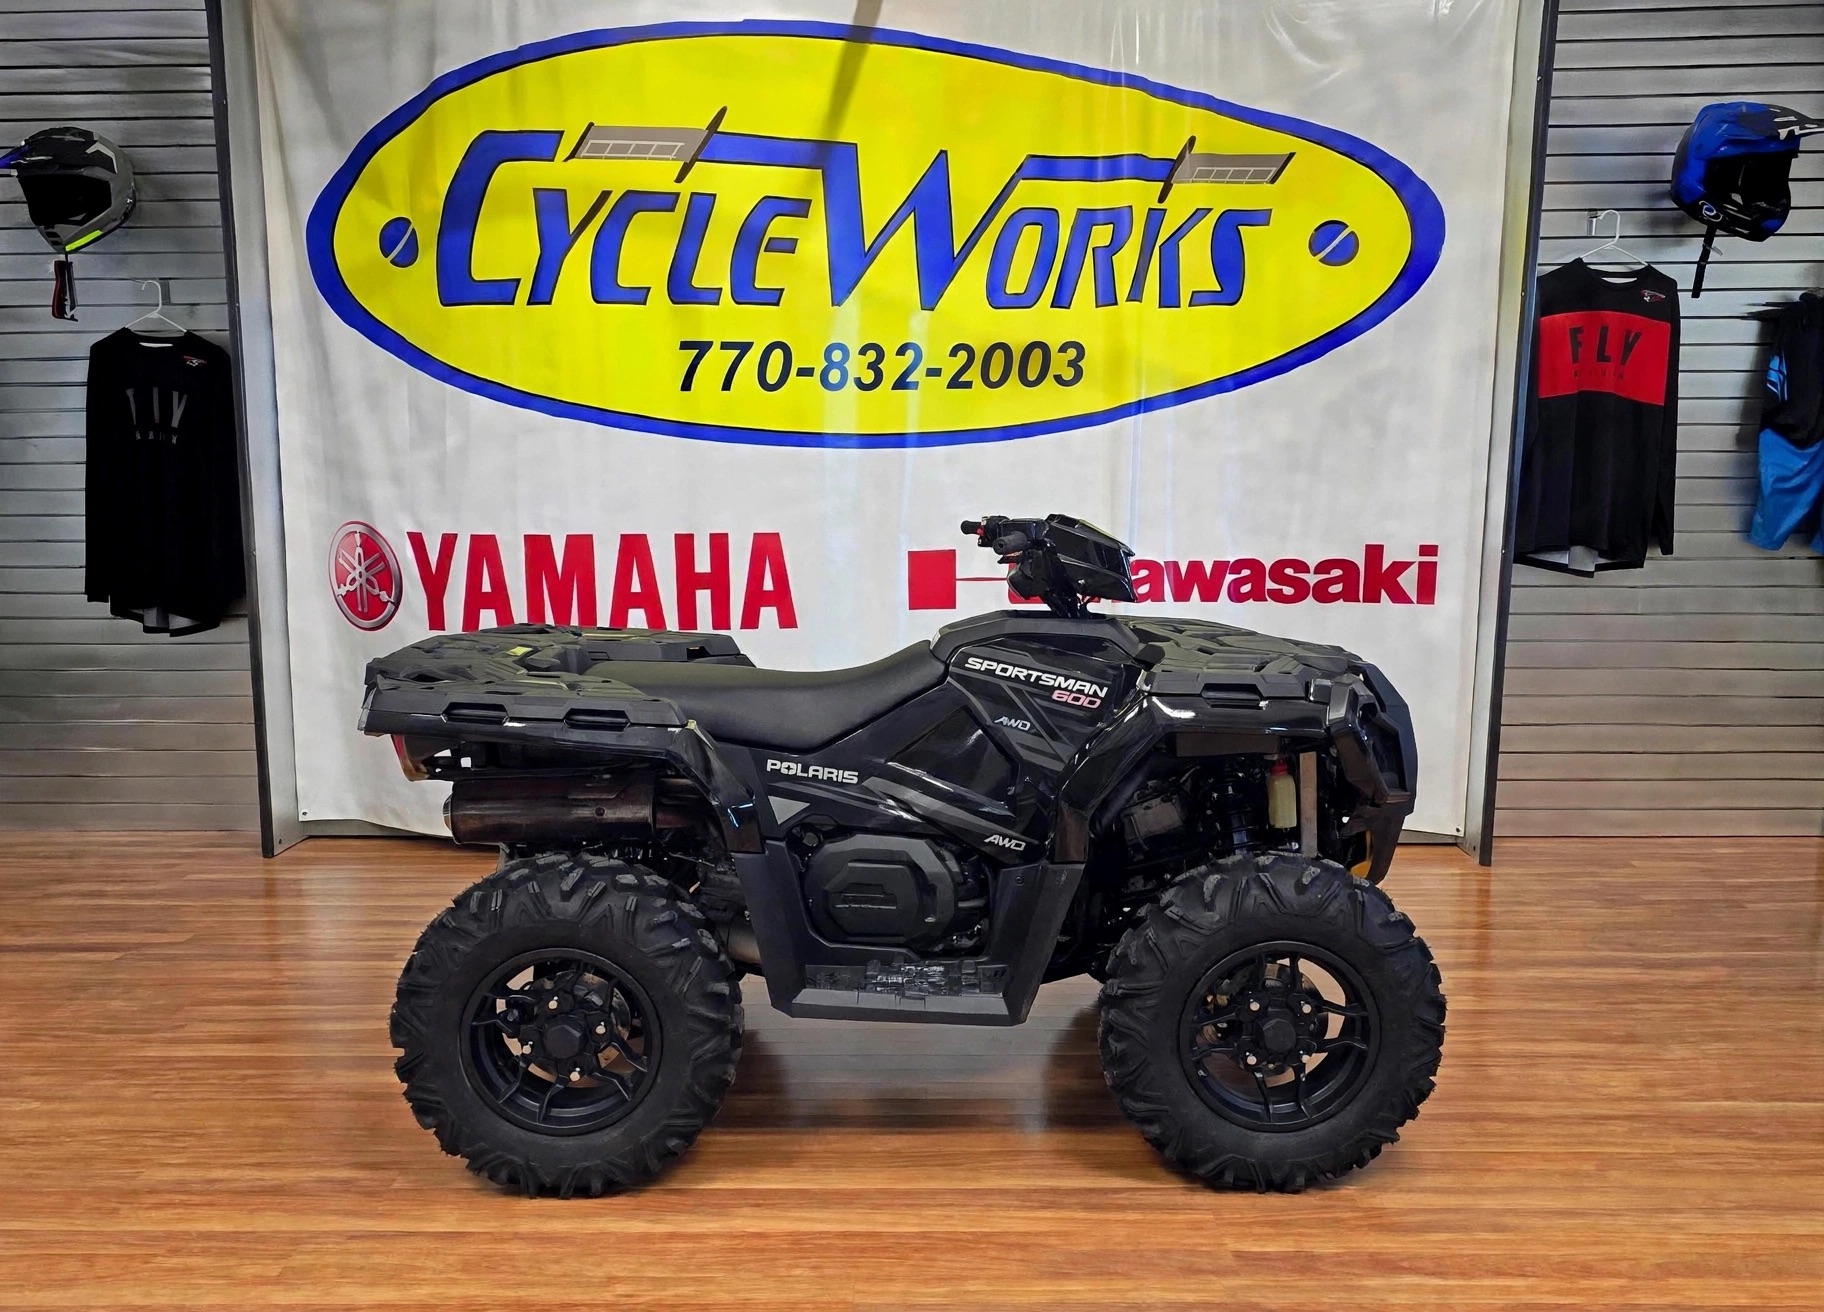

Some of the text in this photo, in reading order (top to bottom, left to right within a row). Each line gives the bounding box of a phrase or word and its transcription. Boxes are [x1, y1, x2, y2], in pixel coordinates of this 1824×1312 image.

[1569, 325, 1643, 366] FLY
[678, 340, 1086, 393] 770-832-2003
[406, 531, 798, 632] YAMAHA
[1008, 543, 1439, 605] awasaki
[965, 657, 1109, 698] SPORTSMAN
[1051, 689, 1102, 709] 600
[994, 715, 1031, 731] AWD
[766, 758, 859, 784] POLARIS
[983, 833, 1026, 851] AWD
